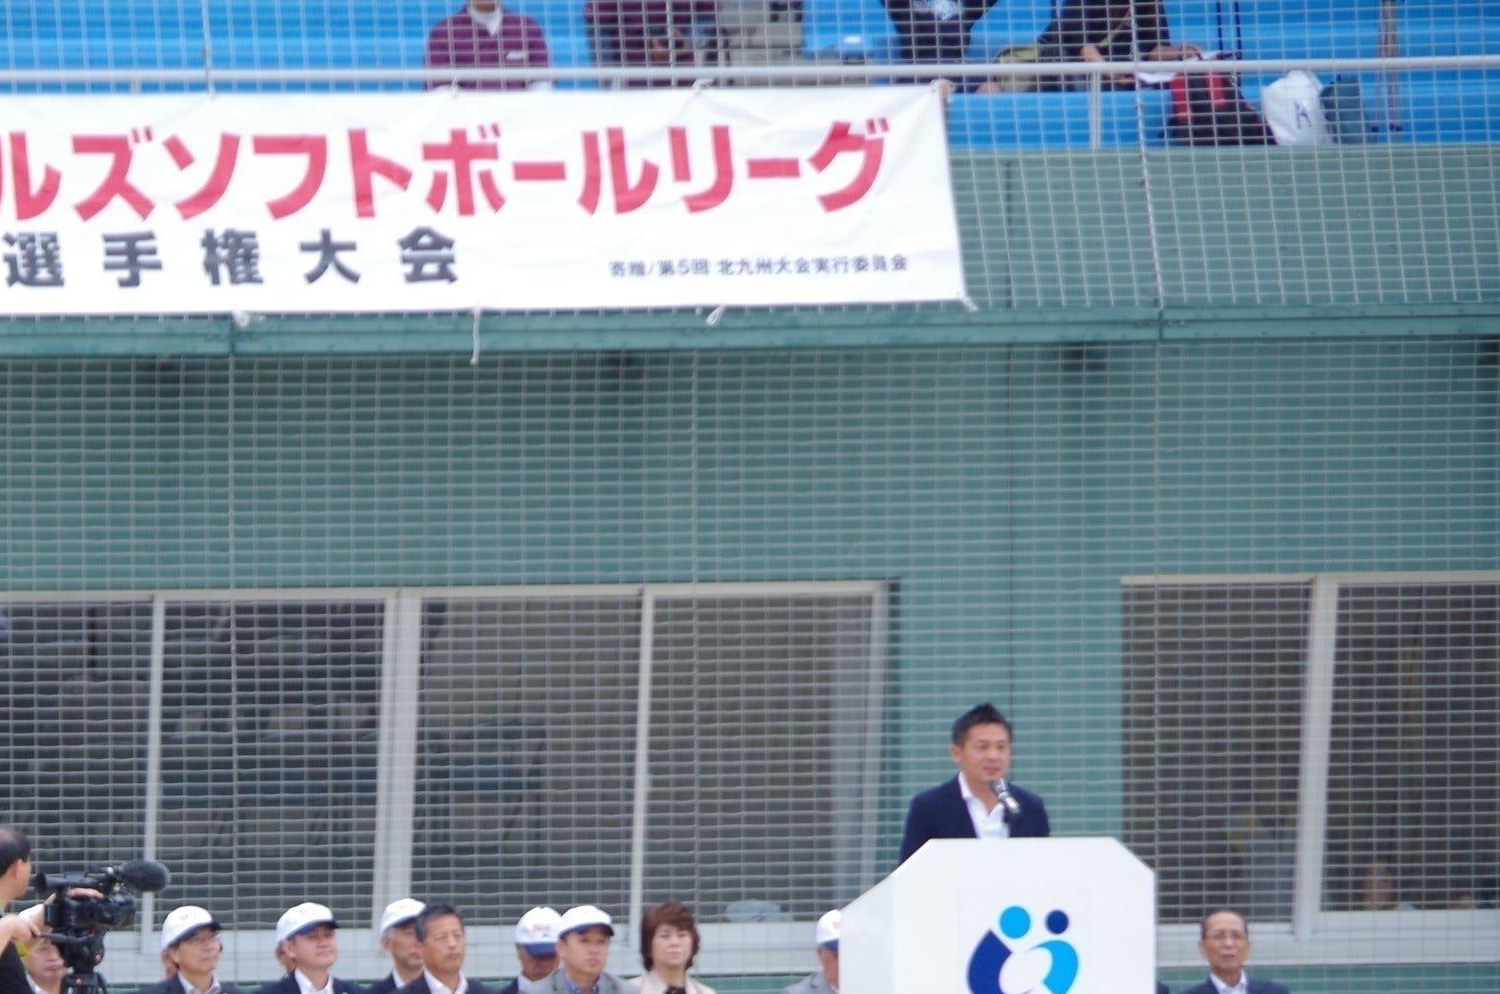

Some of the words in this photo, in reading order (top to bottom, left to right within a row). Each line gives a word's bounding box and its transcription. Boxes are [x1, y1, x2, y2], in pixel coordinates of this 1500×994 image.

[2, 226, 459, 288] 選手権大会
[716, 254, 909, 276] 北九州大会実行委員会
